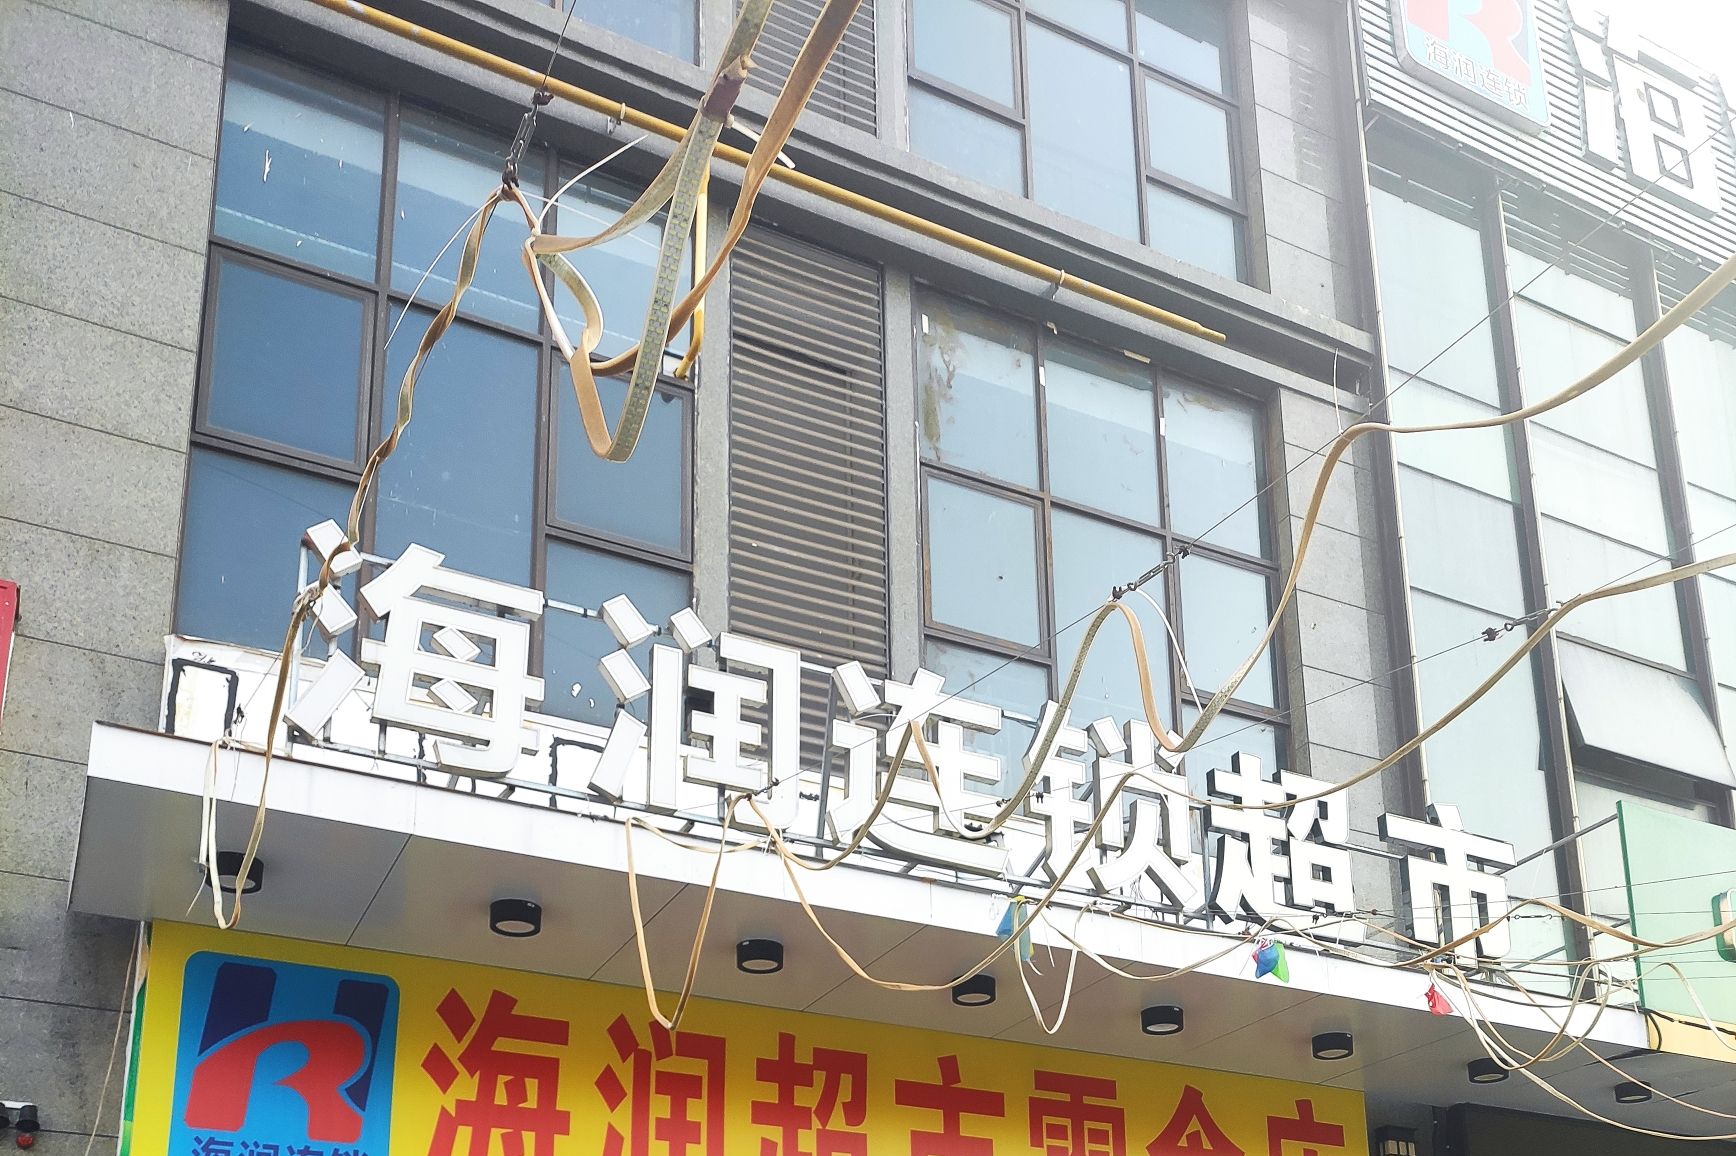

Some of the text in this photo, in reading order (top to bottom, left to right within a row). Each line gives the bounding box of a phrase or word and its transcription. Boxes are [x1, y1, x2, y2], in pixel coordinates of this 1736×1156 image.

[1424, 34, 1531, 112] 海润连锁
[283, 518, 1516, 967] 海润连锁超市
